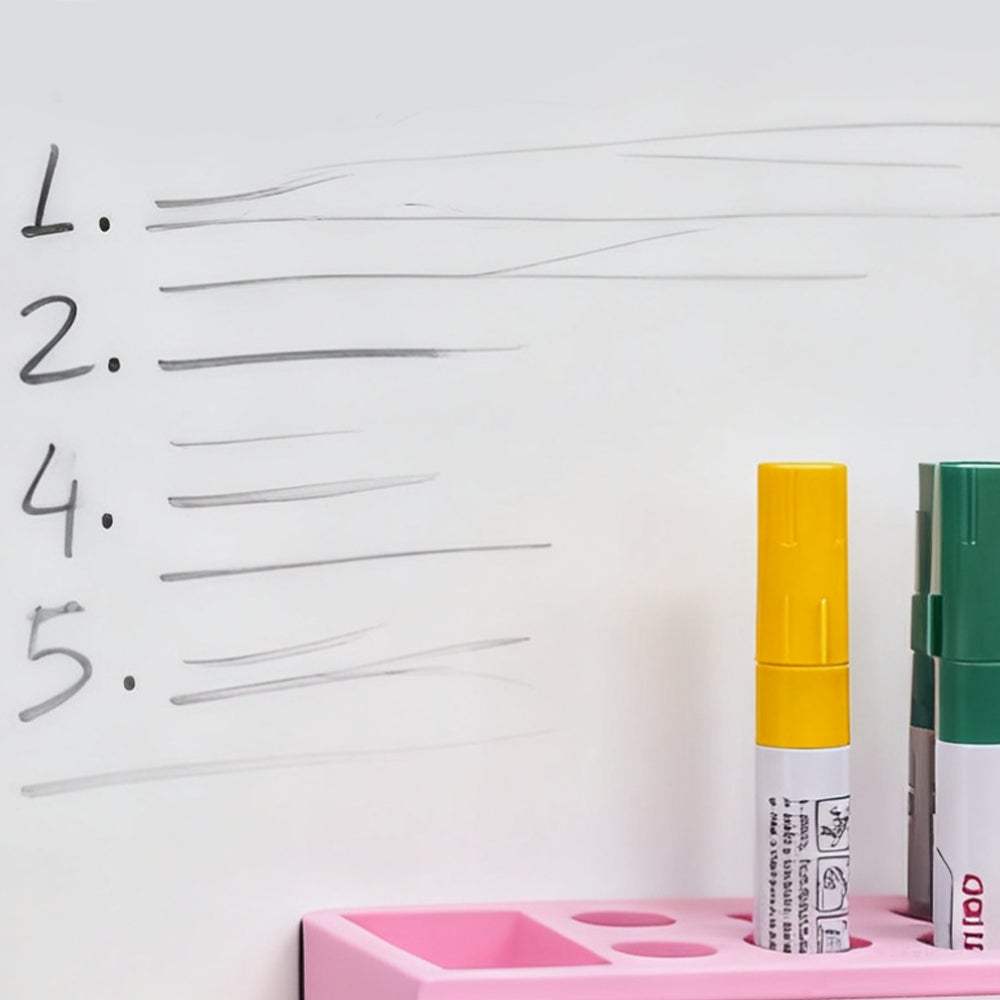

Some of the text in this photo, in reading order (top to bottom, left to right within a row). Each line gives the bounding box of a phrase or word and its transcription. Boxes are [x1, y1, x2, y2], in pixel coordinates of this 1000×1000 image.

[20, 143, 112, 238] 1.
[20, 295, 122, 385] 2.
[22, 443, 115, 558] 4.
[18, 600, 137, 723] 5.
